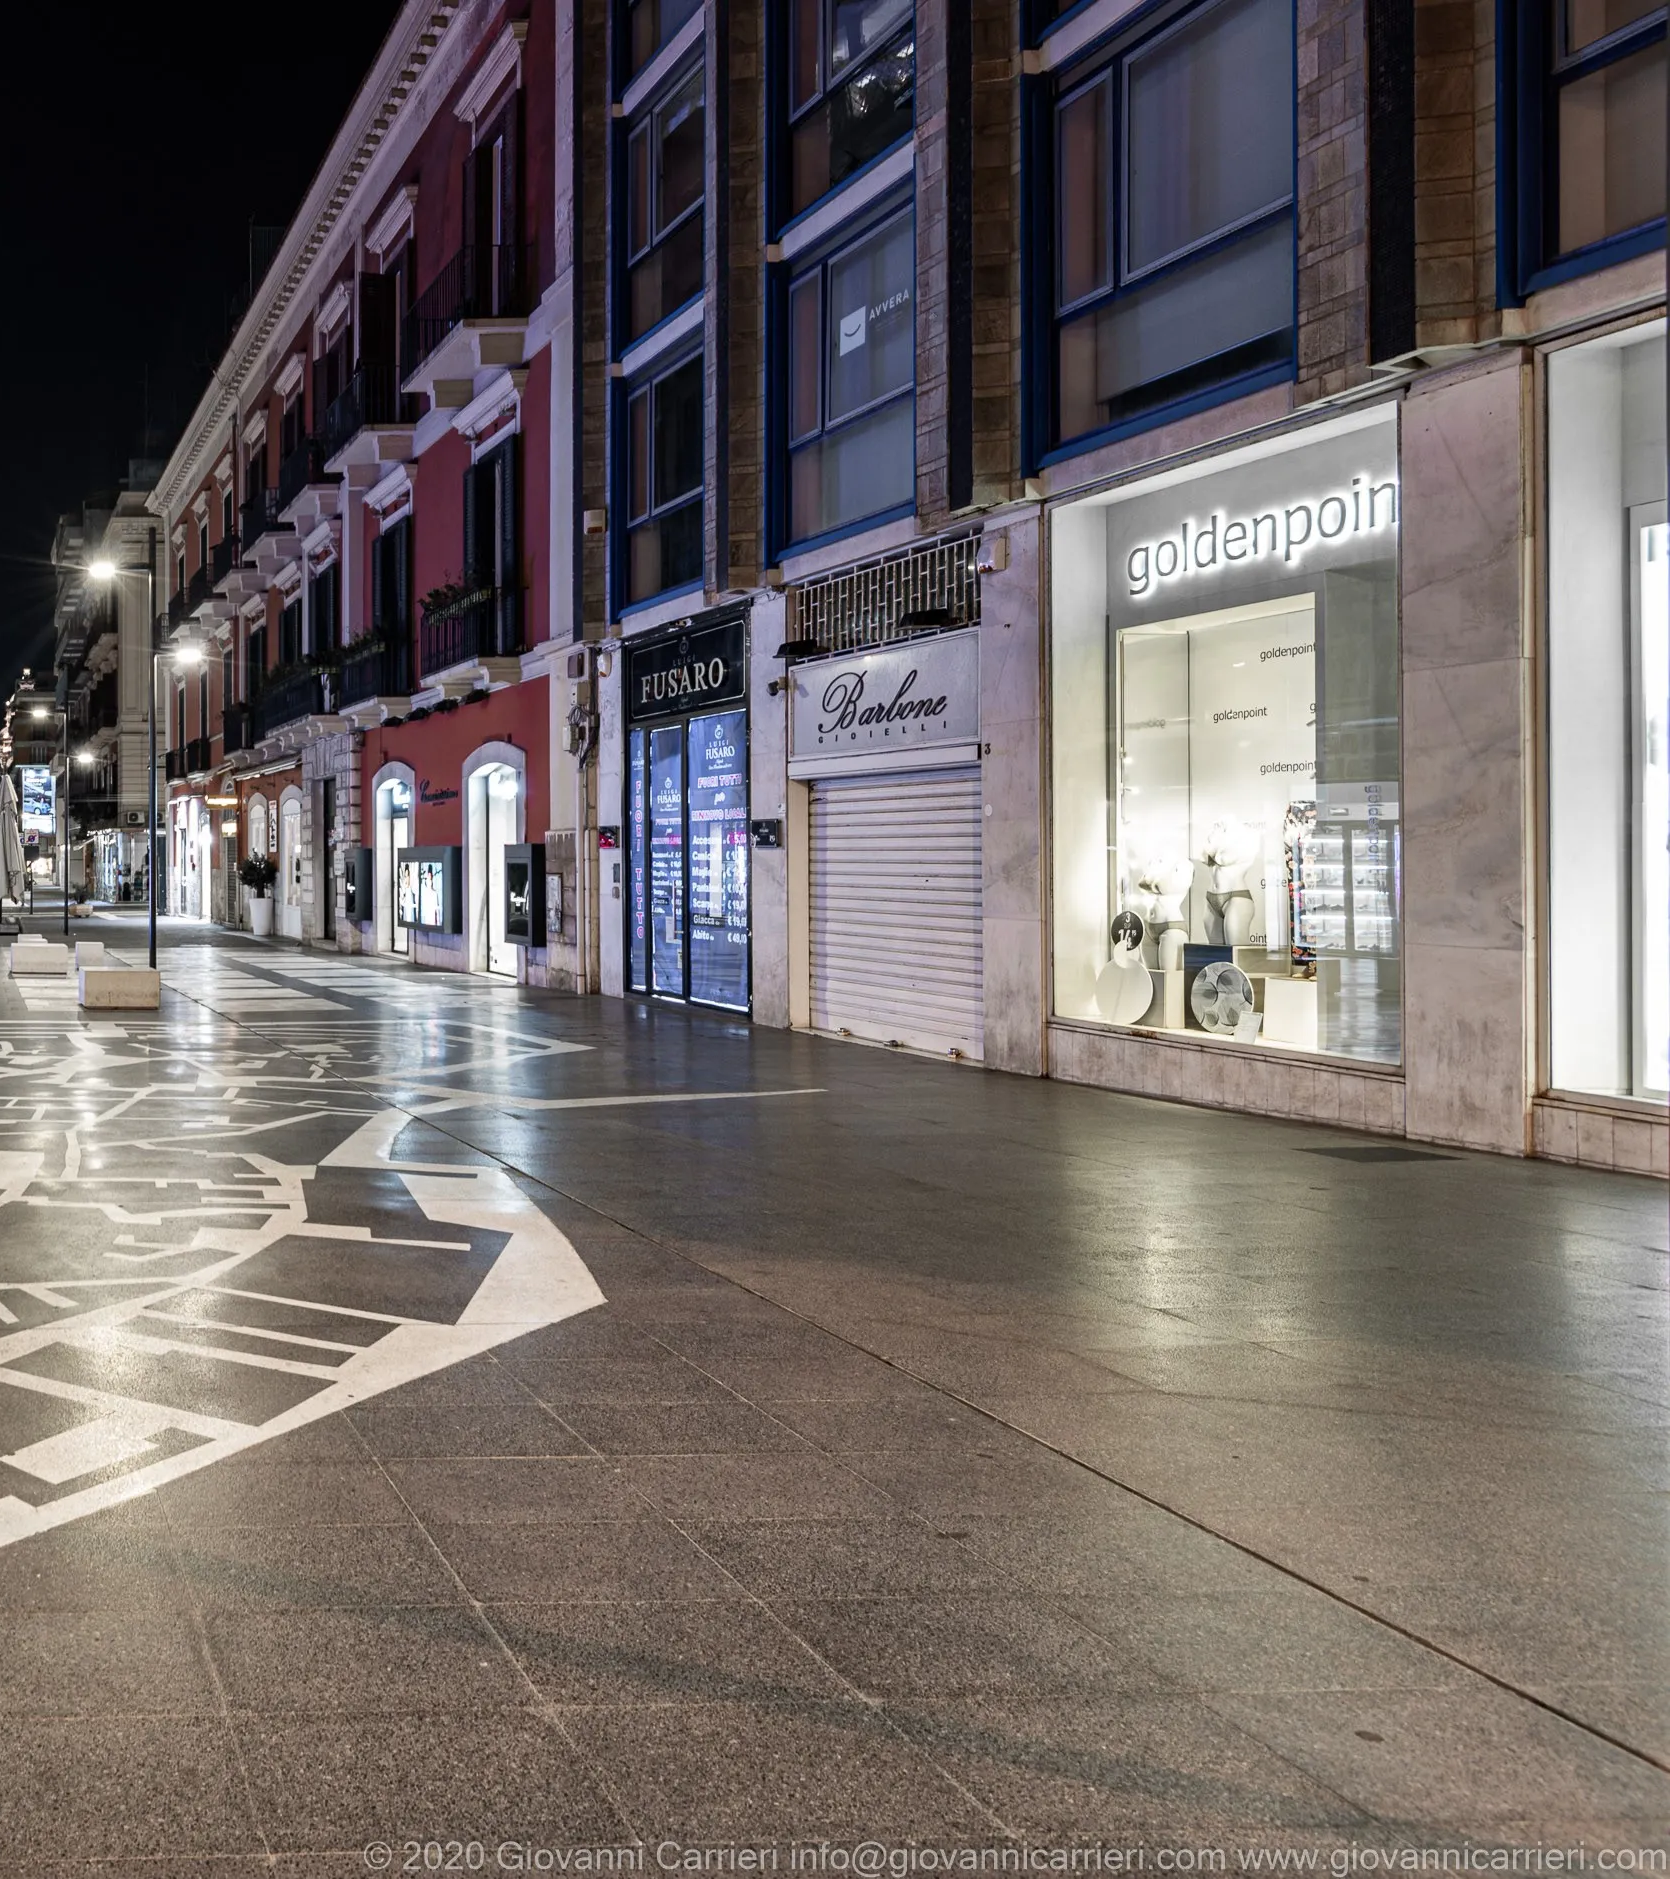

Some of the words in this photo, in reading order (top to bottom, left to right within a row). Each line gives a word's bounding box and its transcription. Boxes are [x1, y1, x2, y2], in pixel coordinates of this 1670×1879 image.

[869, 288, 910, 322] AVVERA
[1127, 478, 1398, 596] goldenpoin
[641, 657, 724, 703] FUSARO
[818, 669, 948, 734] Barbone
[1213, 706, 1268, 723] goldenpoint
[709, 740, 729, 748] LUIGI
[818, 720, 947, 744] GIOIELLI
[706, 745, 735, 760] FUSARO
[1125, 912, 1131, 923] 3
